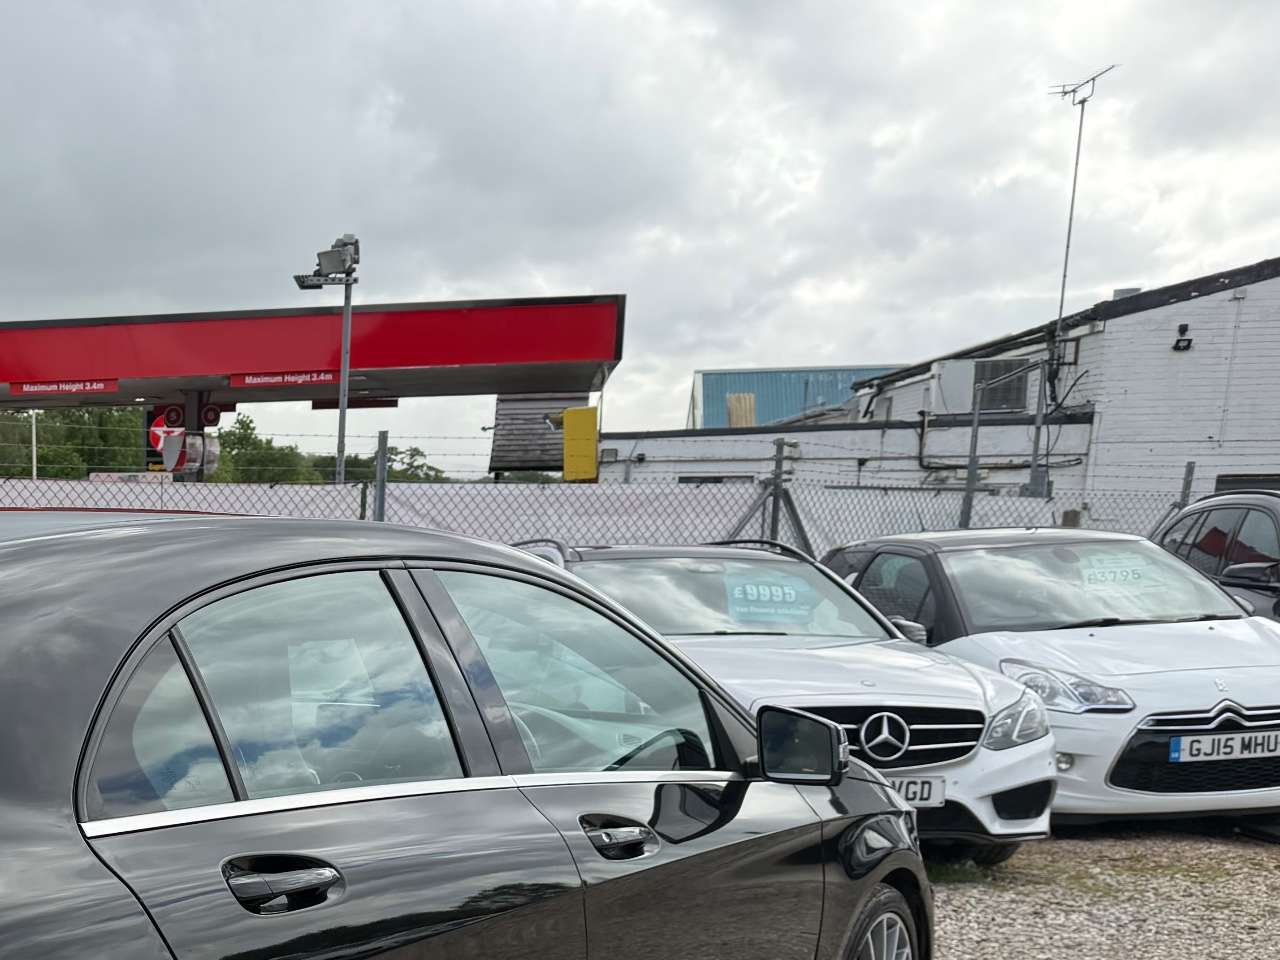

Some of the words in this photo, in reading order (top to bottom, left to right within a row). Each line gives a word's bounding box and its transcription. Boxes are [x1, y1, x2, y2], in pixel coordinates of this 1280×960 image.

[245, 375, 283, 384] Maximum
[283, 373, 311, 383] Height
[311, 373, 333, 381] 3.4m
[23, 383, 58, 391] Maximum
[59, 382, 84, 392] Height
[84, 382, 104, 390] 3.4m
[734, 584, 796, 602] £9995
[1189, 737, 1234, 757] GJ15
[1240, 734, 1278, 754] MHU
